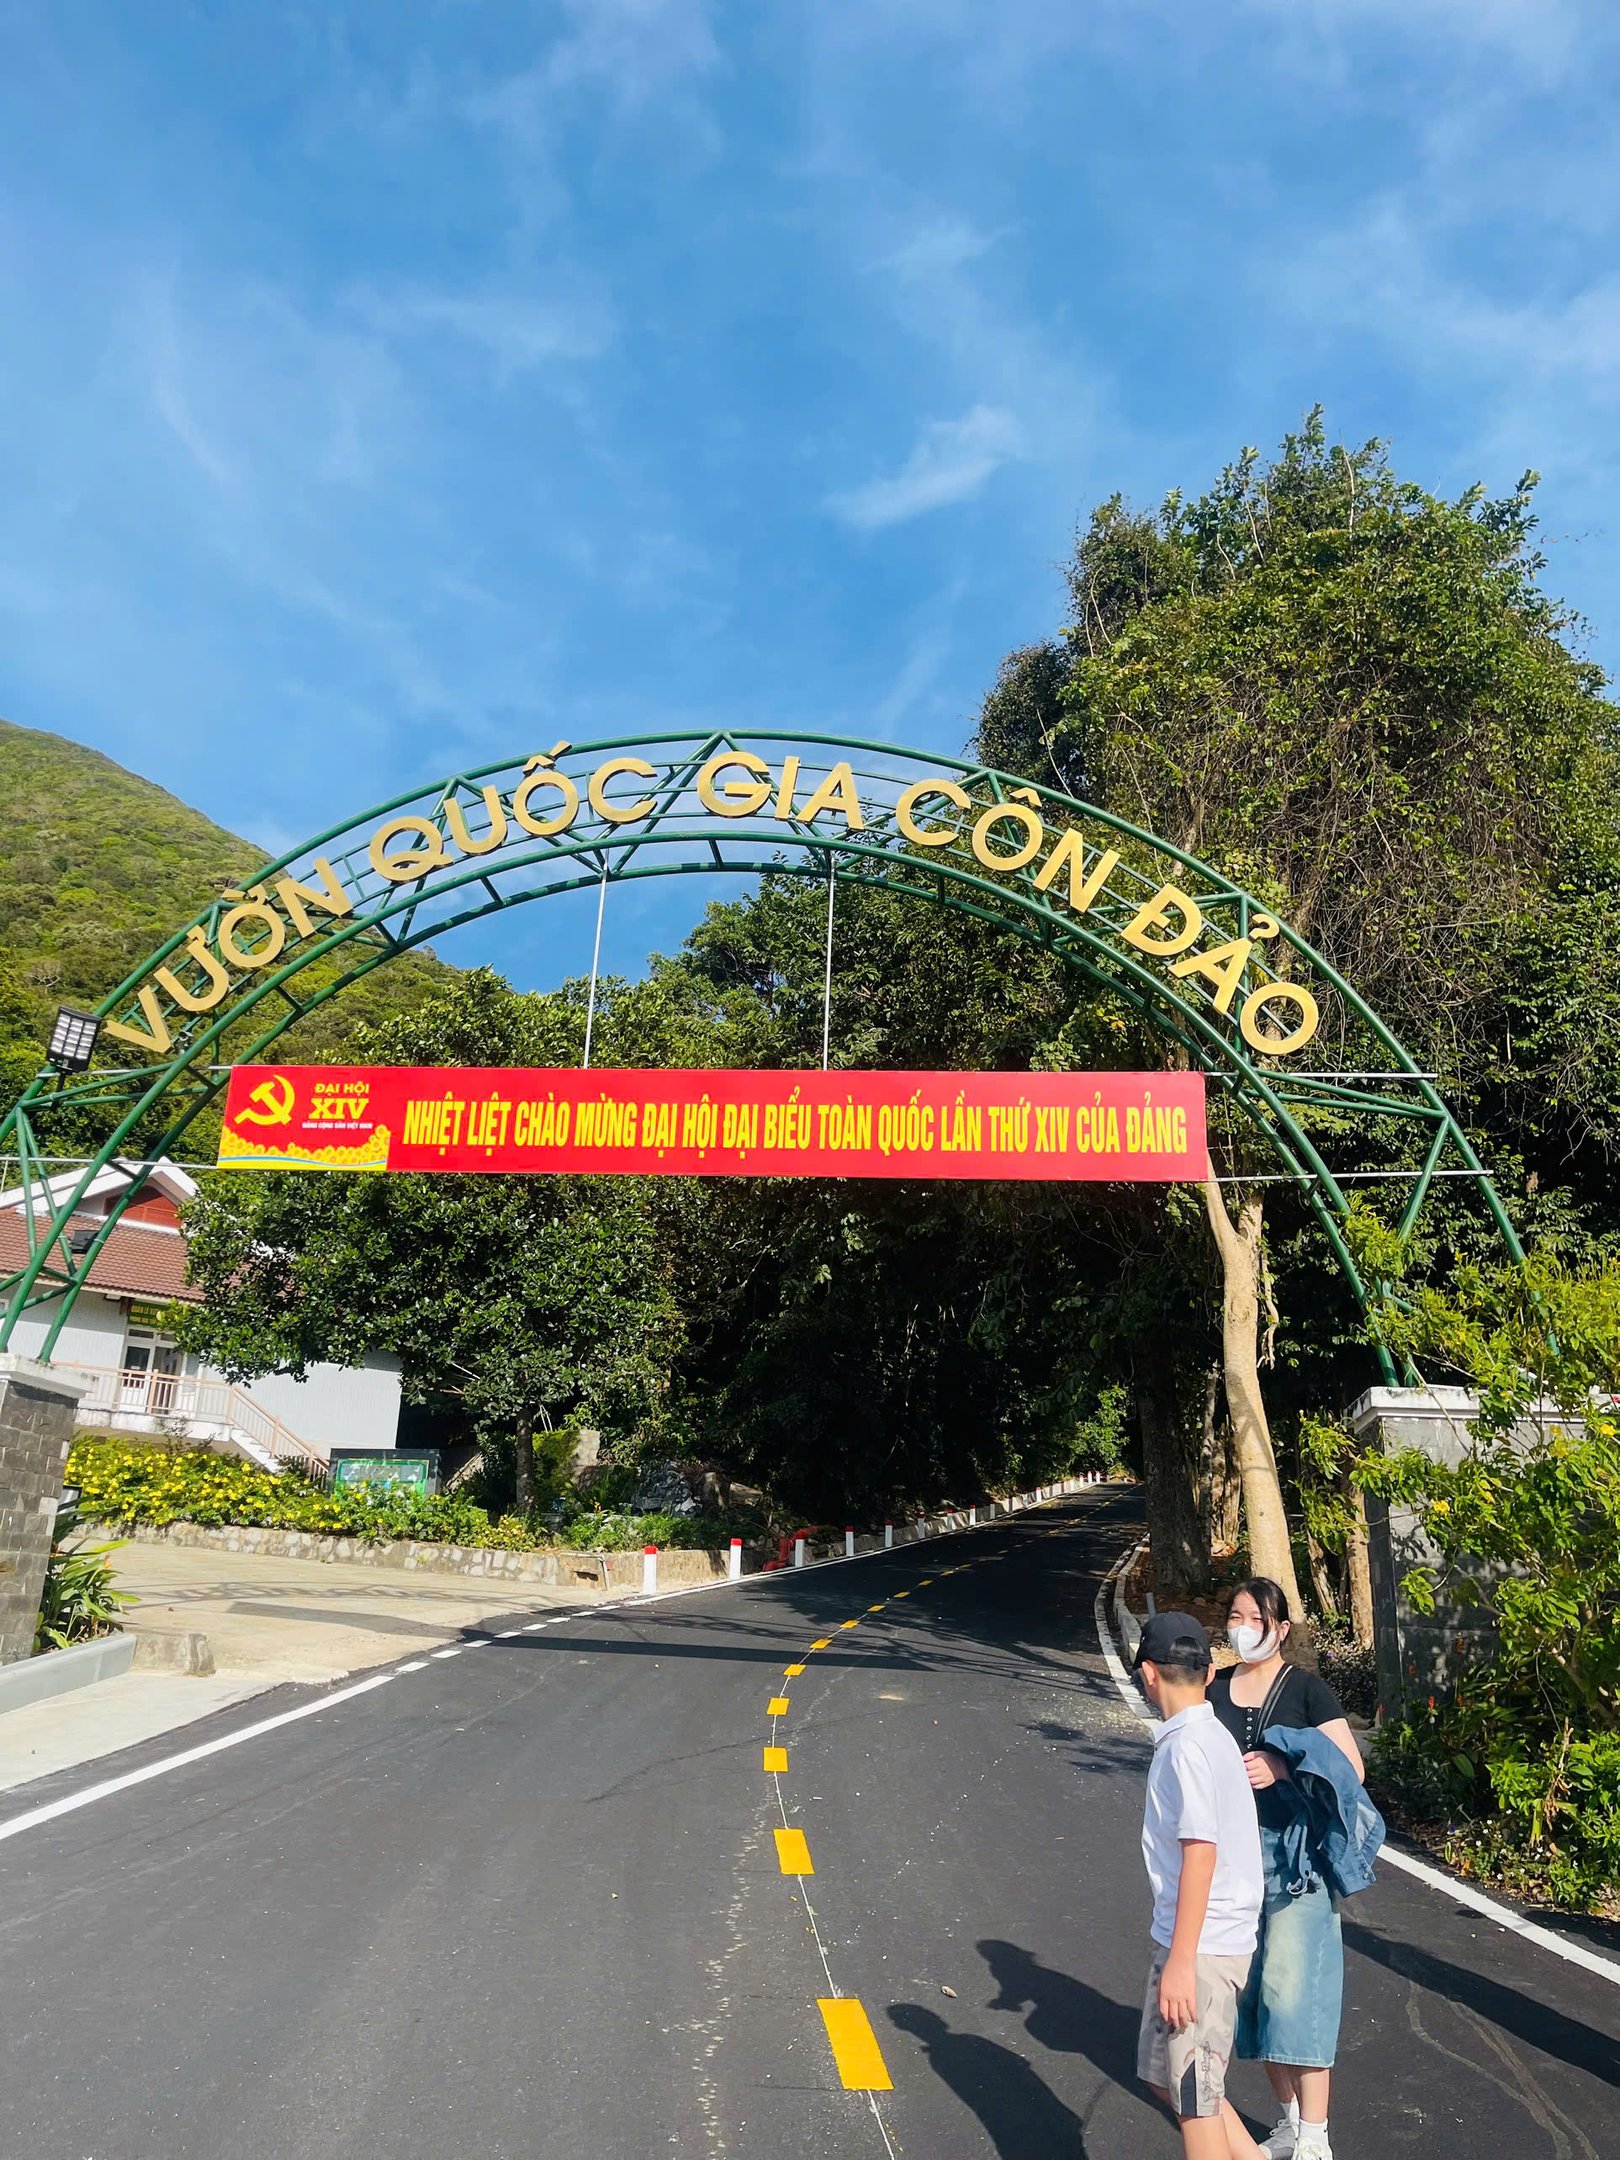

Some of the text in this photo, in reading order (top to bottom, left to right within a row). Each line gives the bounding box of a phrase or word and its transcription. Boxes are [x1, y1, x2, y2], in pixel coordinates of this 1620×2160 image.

[103, 740, 1319, 1055] VƯỜN QUỐC GIA CÔN ĐẢO
[308, 1097, 369, 1120] XIV
[314, 1081, 370, 1096] ĐẠI HỘI
[404, 1085, 1187, 1159] NHIỆT LIỆT CHÀO MỪNG ĐẠI HỘI ĐẠI BIỂU TOÀN QUỐC LẦN THỨ XIV CỦA ĐẢNG
